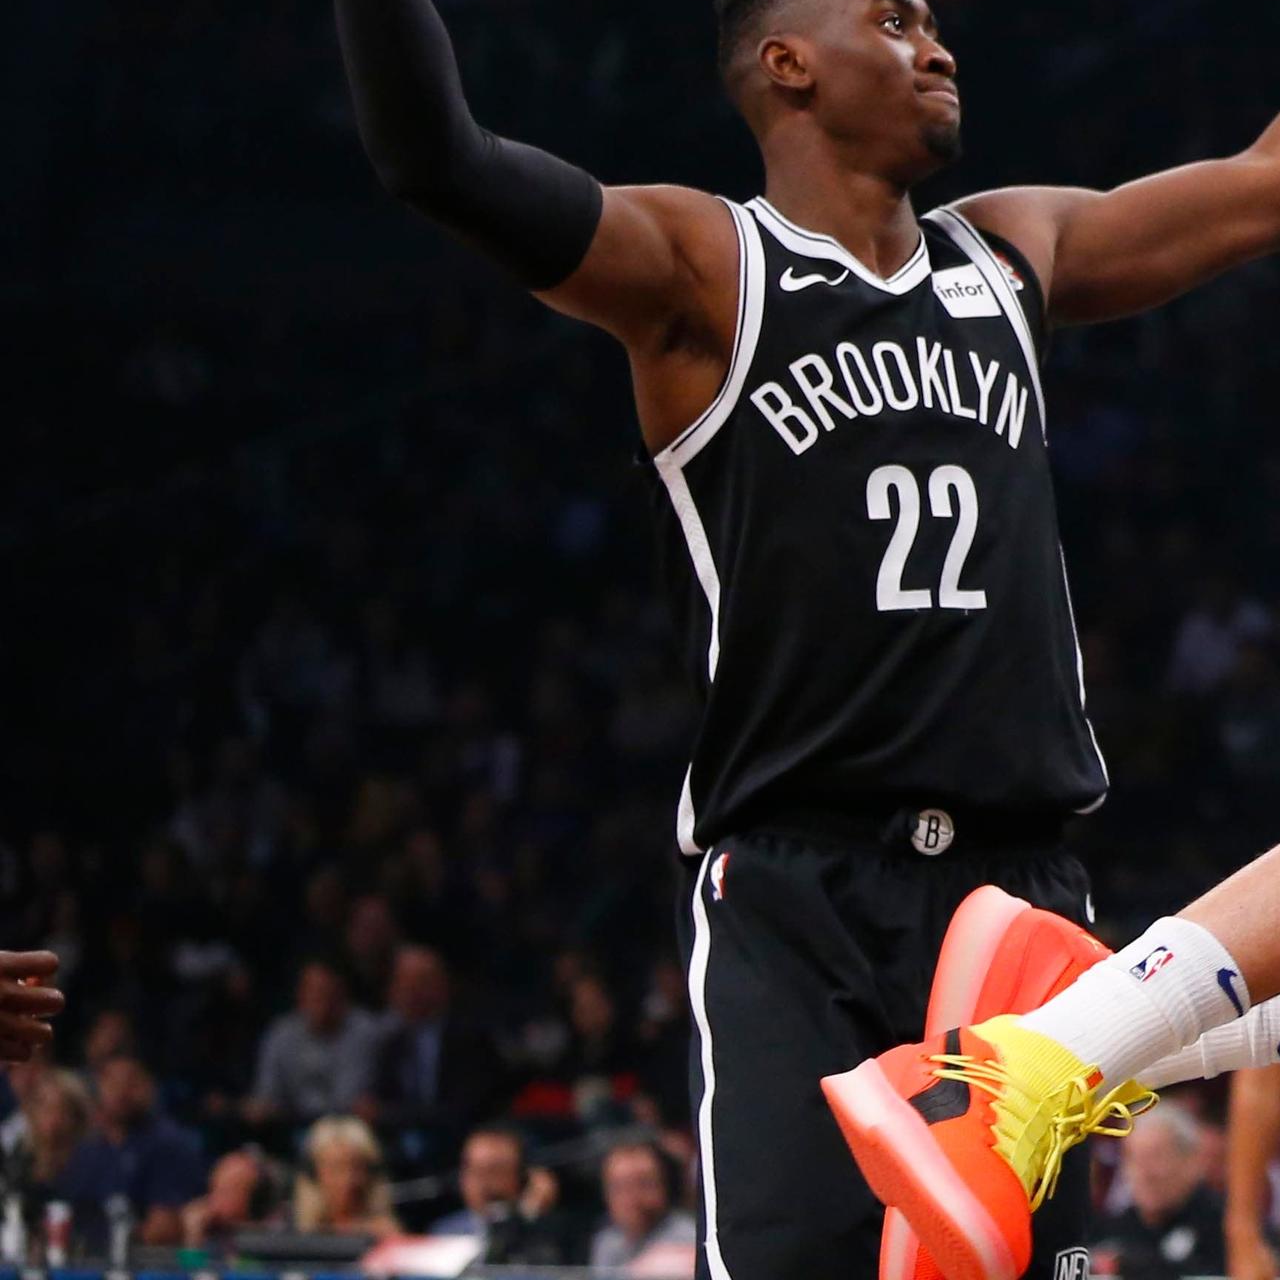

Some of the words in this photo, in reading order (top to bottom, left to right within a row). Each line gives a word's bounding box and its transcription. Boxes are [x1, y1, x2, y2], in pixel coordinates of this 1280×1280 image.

[936, 281, 984, 300] infor
[749, 337, 1028, 456] BROOKLYN
[866, 464, 988, 612] 22
